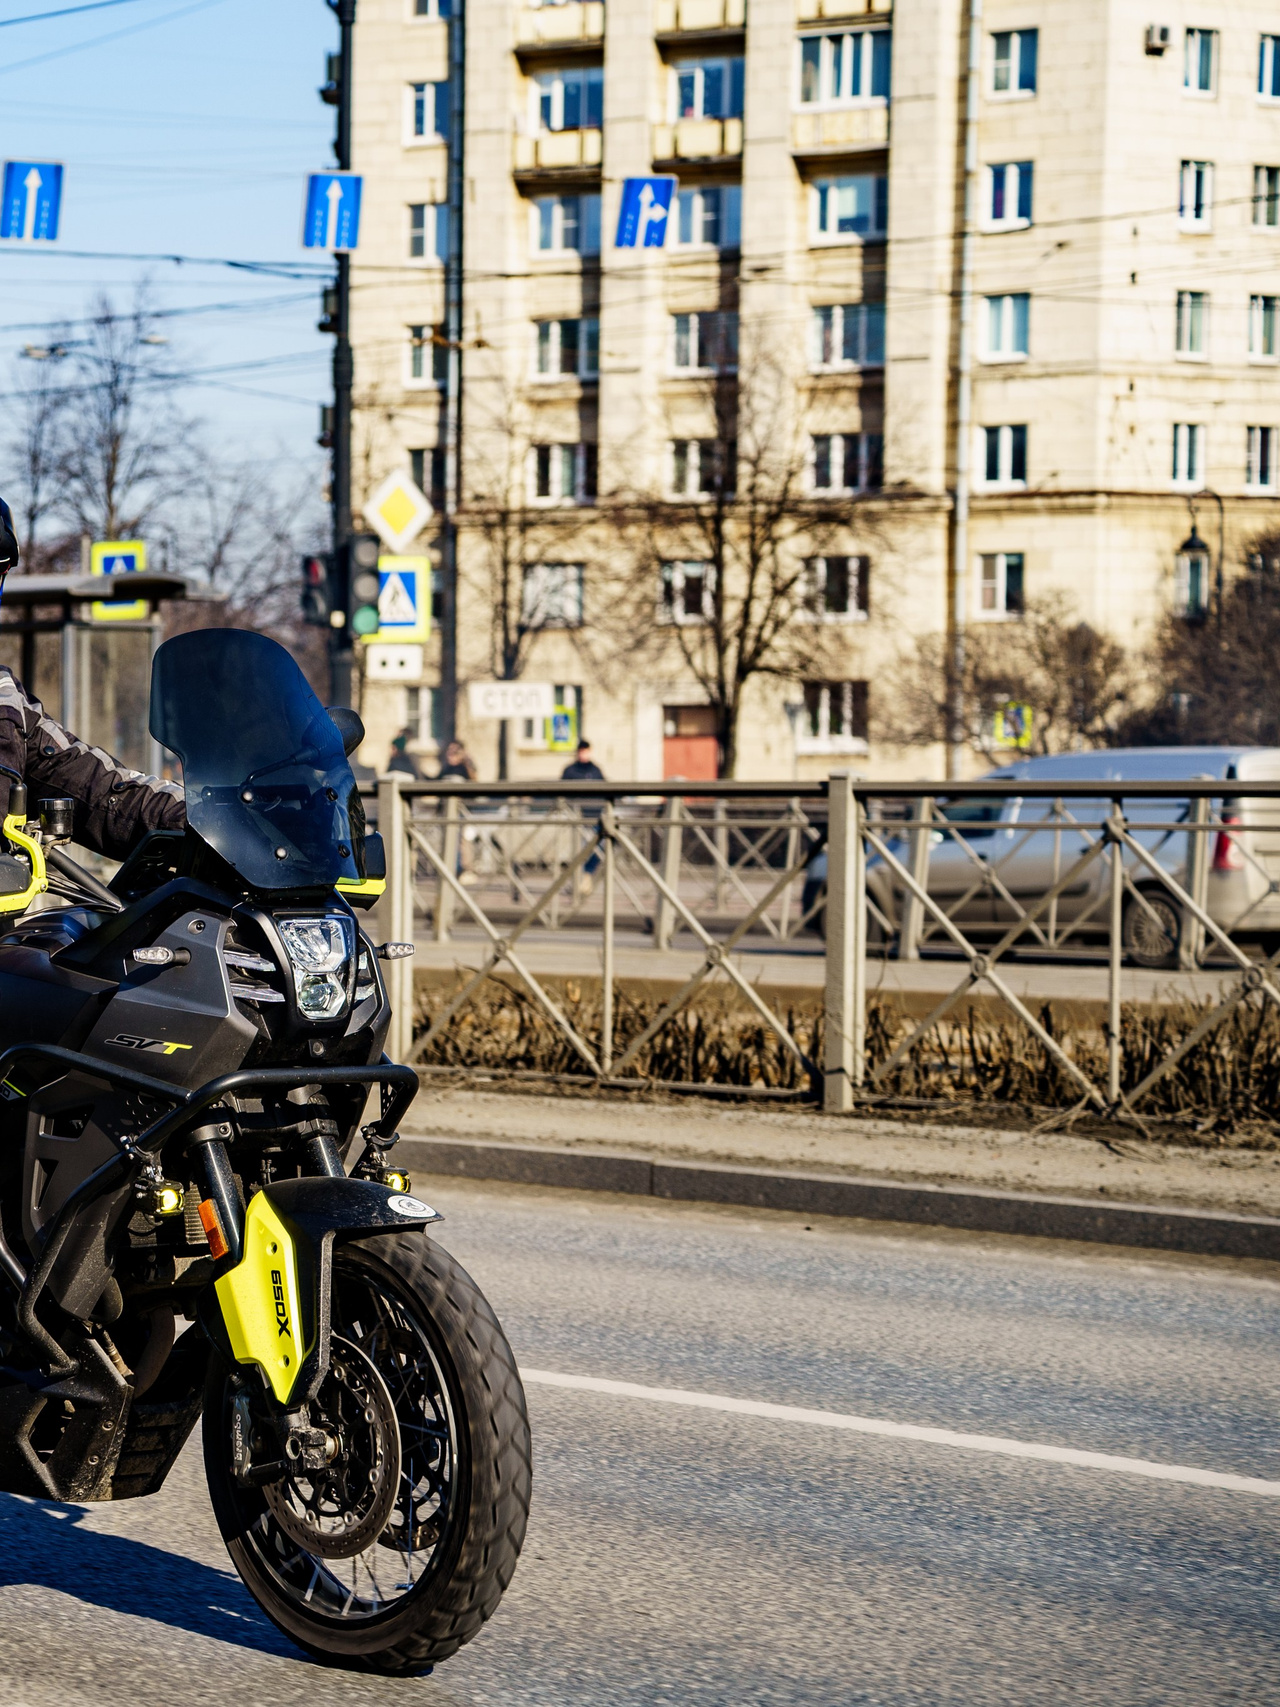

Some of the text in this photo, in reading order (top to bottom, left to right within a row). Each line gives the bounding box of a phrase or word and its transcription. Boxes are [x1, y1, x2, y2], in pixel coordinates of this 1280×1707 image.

[482, 688, 541, 711] СТОП
[103, 1033, 193, 1055] SVT
[271, 1269, 292, 1339] 650X
[234, 1413, 243, 1461] brembo
